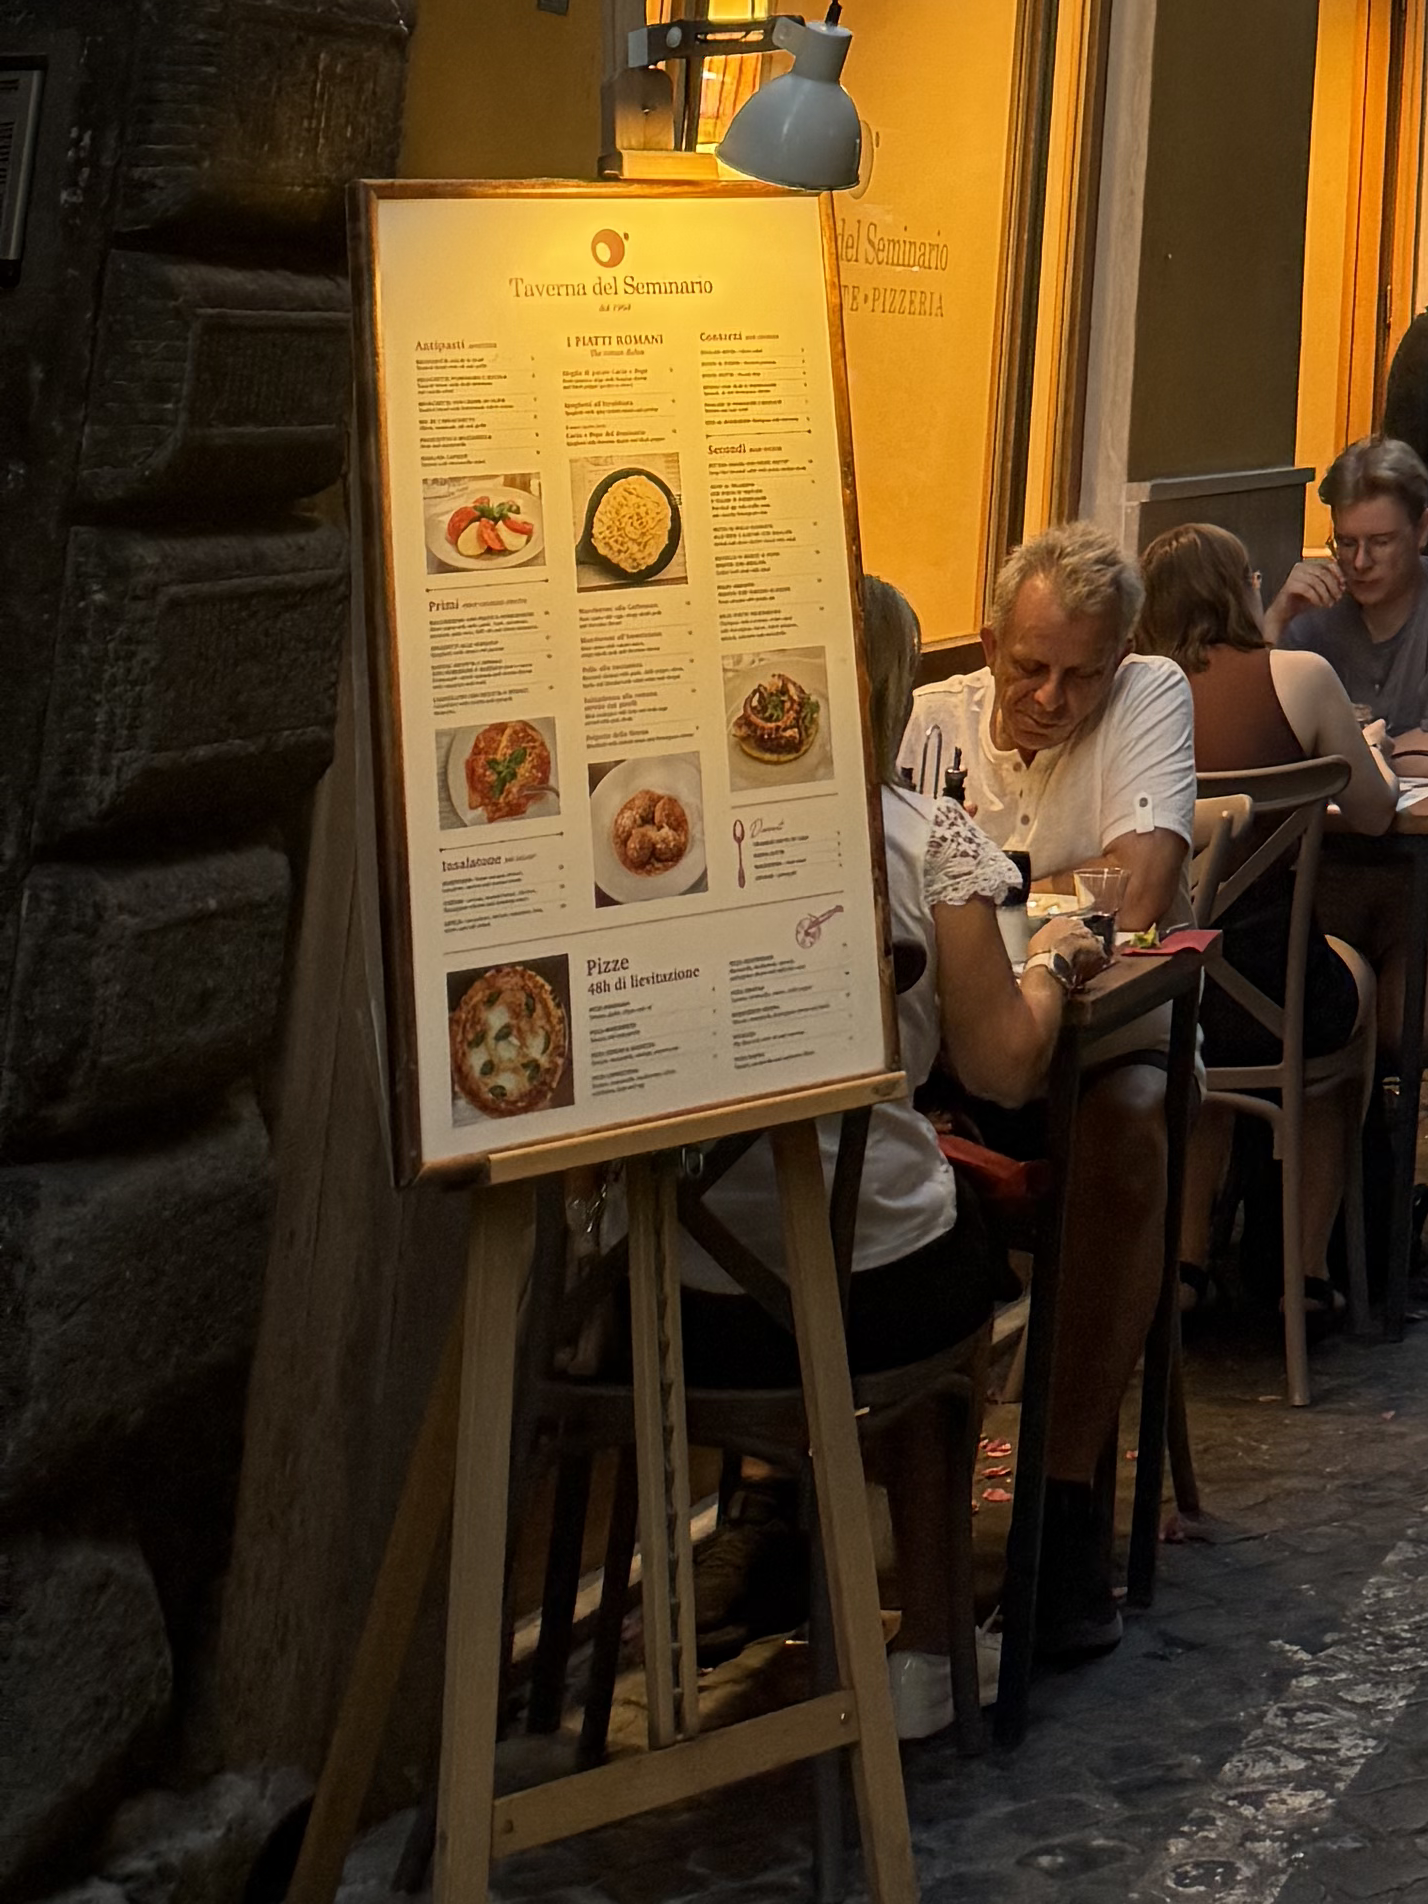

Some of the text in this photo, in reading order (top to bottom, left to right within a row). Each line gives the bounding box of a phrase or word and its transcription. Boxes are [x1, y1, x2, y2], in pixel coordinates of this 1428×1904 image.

[865, 222, 949, 271] Seminario
[509, 275, 713, 298] Taverna del Seminario
[871, 288, 944, 317] PIZZERIA
[415, 340, 465, 353] Antipasti
[575, 336, 612, 348] PIATTI
[616, 334, 664, 345] ROMANI
[429, 598, 459, 612] Primi
[586, 957, 630, 977] Pizze
[588, 967, 700, 996] 48h di lievitazione
